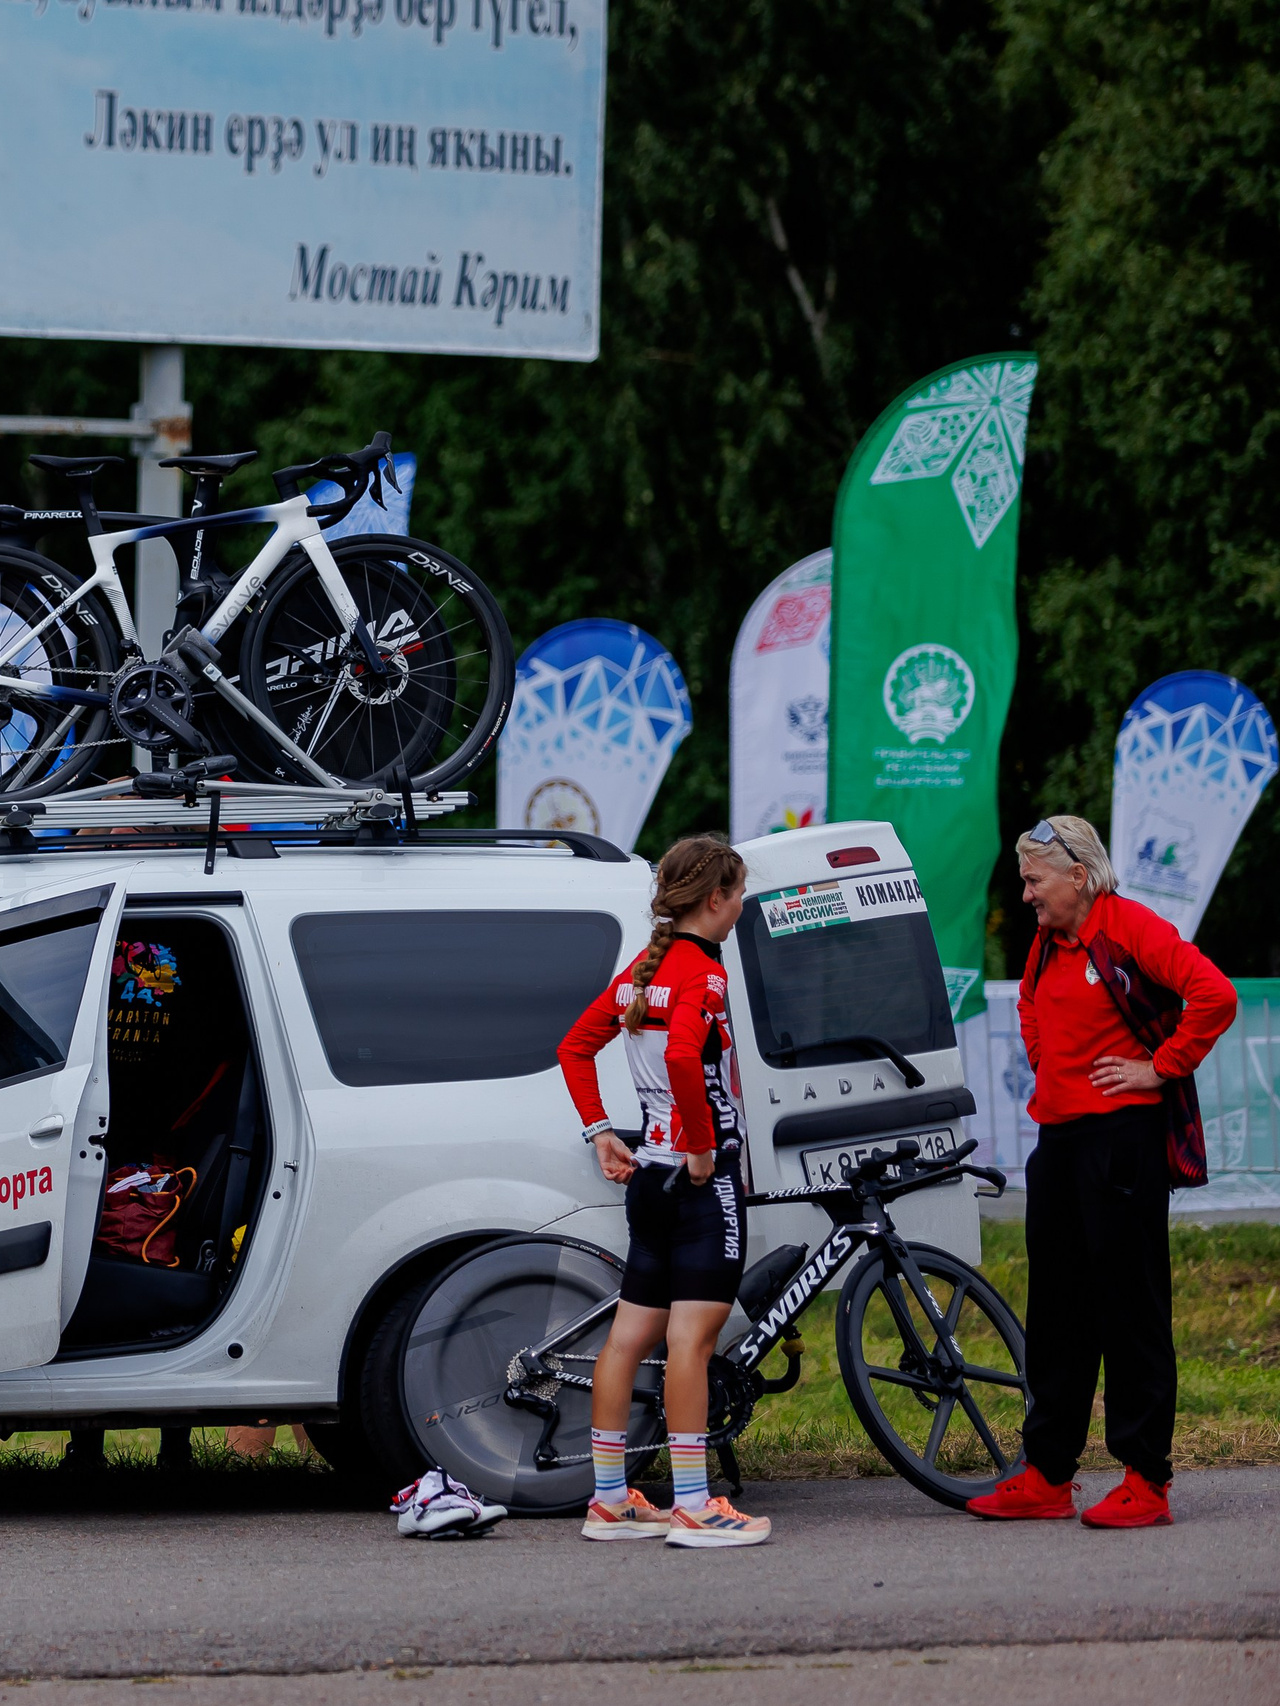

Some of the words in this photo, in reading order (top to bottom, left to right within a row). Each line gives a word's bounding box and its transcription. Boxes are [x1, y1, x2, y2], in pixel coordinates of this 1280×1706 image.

[83, 90, 214, 153] Ләкин
[315, 118, 362, 177] ул
[289, 242, 443, 305] Мостай
[453, 250, 571, 327] Кәрим
[189, 528, 205, 581] BOLIDE
[407, 551, 474, 595] DRIVE
[40, 573, 100, 627] DRVE
[210, 574, 262, 639] evolve
[787, 903, 834, 924] РОССИИ
[855, 878, 924, 906] КОМАНДА
[108, 1027, 160, 1043] RANJA
[768, 1073, 885, 1105] LADA
[765, 1182, 843, 1200] SPECIALIZED
[714, 1175, 740, 1260] УДМУРТИЯ
[739, 1226, 852, 1367] S-WORKS
[554, 1371, 593, 1386] SPECIA
